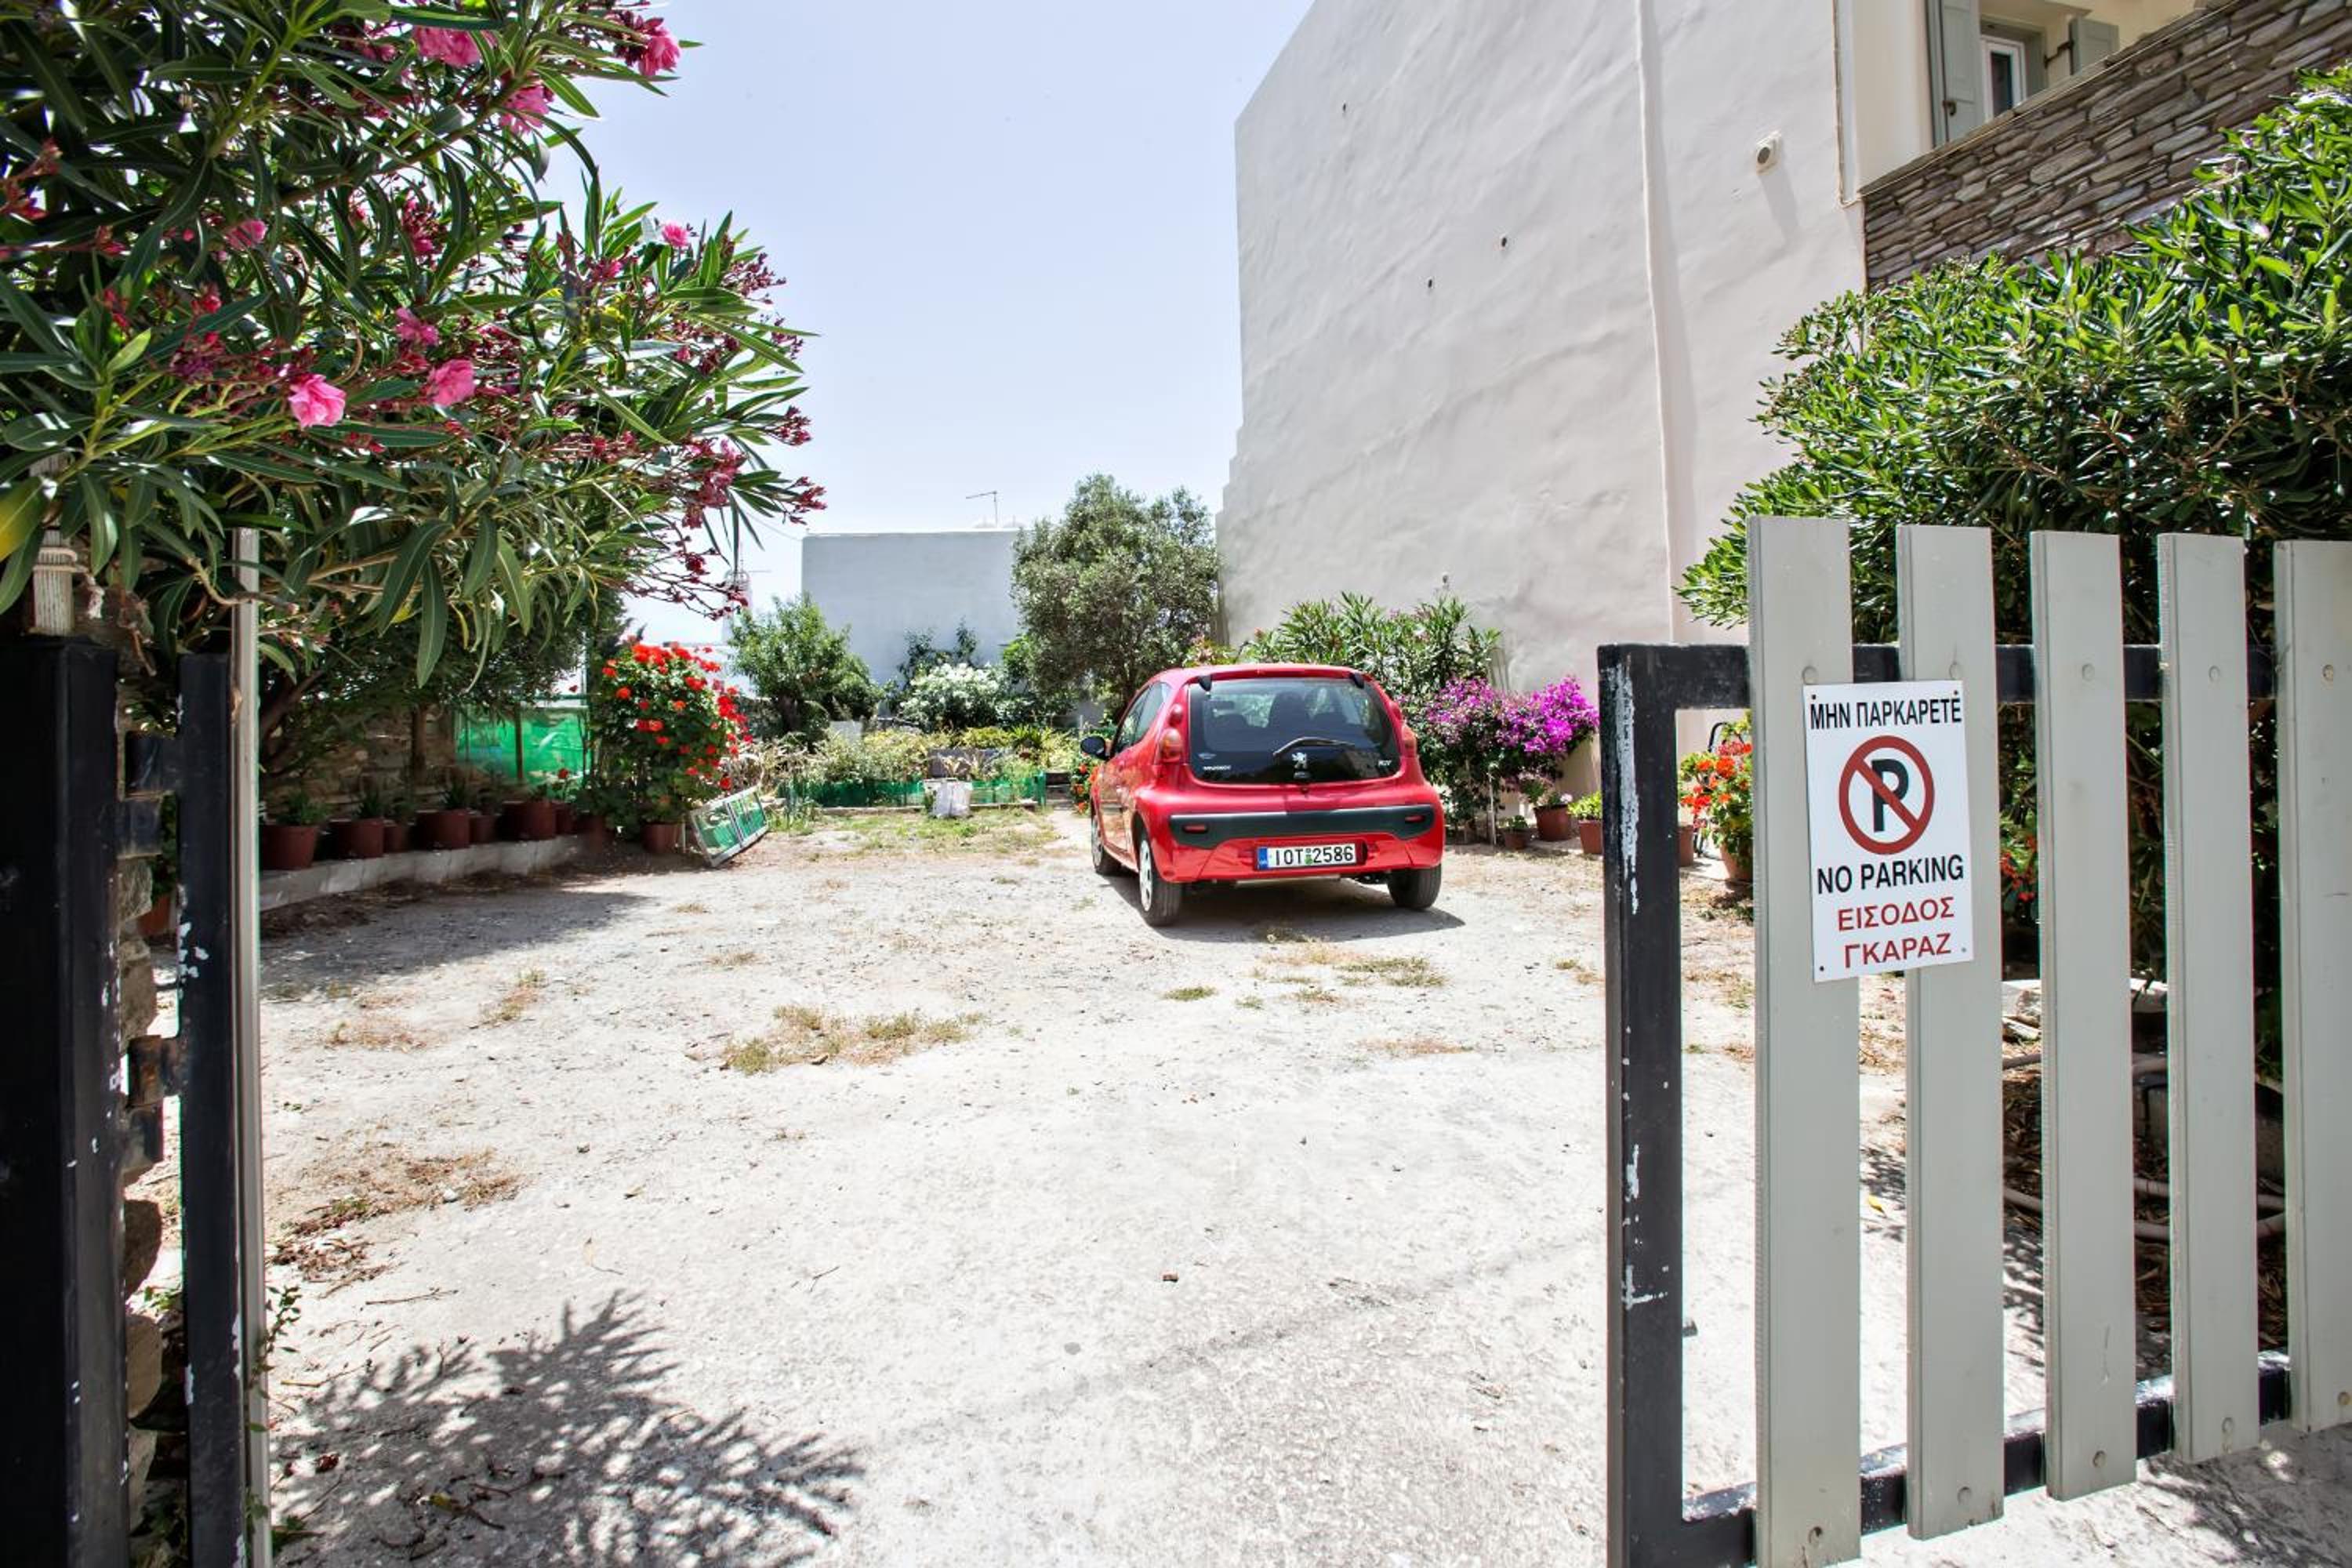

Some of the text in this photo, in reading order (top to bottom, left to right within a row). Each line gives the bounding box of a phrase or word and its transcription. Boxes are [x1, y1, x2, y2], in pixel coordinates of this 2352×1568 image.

[1810, 697, 1962, 730] ΜΗΝ ΠΑΡΚΑΡΕΤΕ
[1312, 846, 1353, 863] 2586
[1817, 855, 1964, 895] NO PARKING
[1838, 897, 1955, 931] ΕΙΣΟΔΟΣ
[1844, 933, 1951, 968] ΓΚΑΡΑΖ
